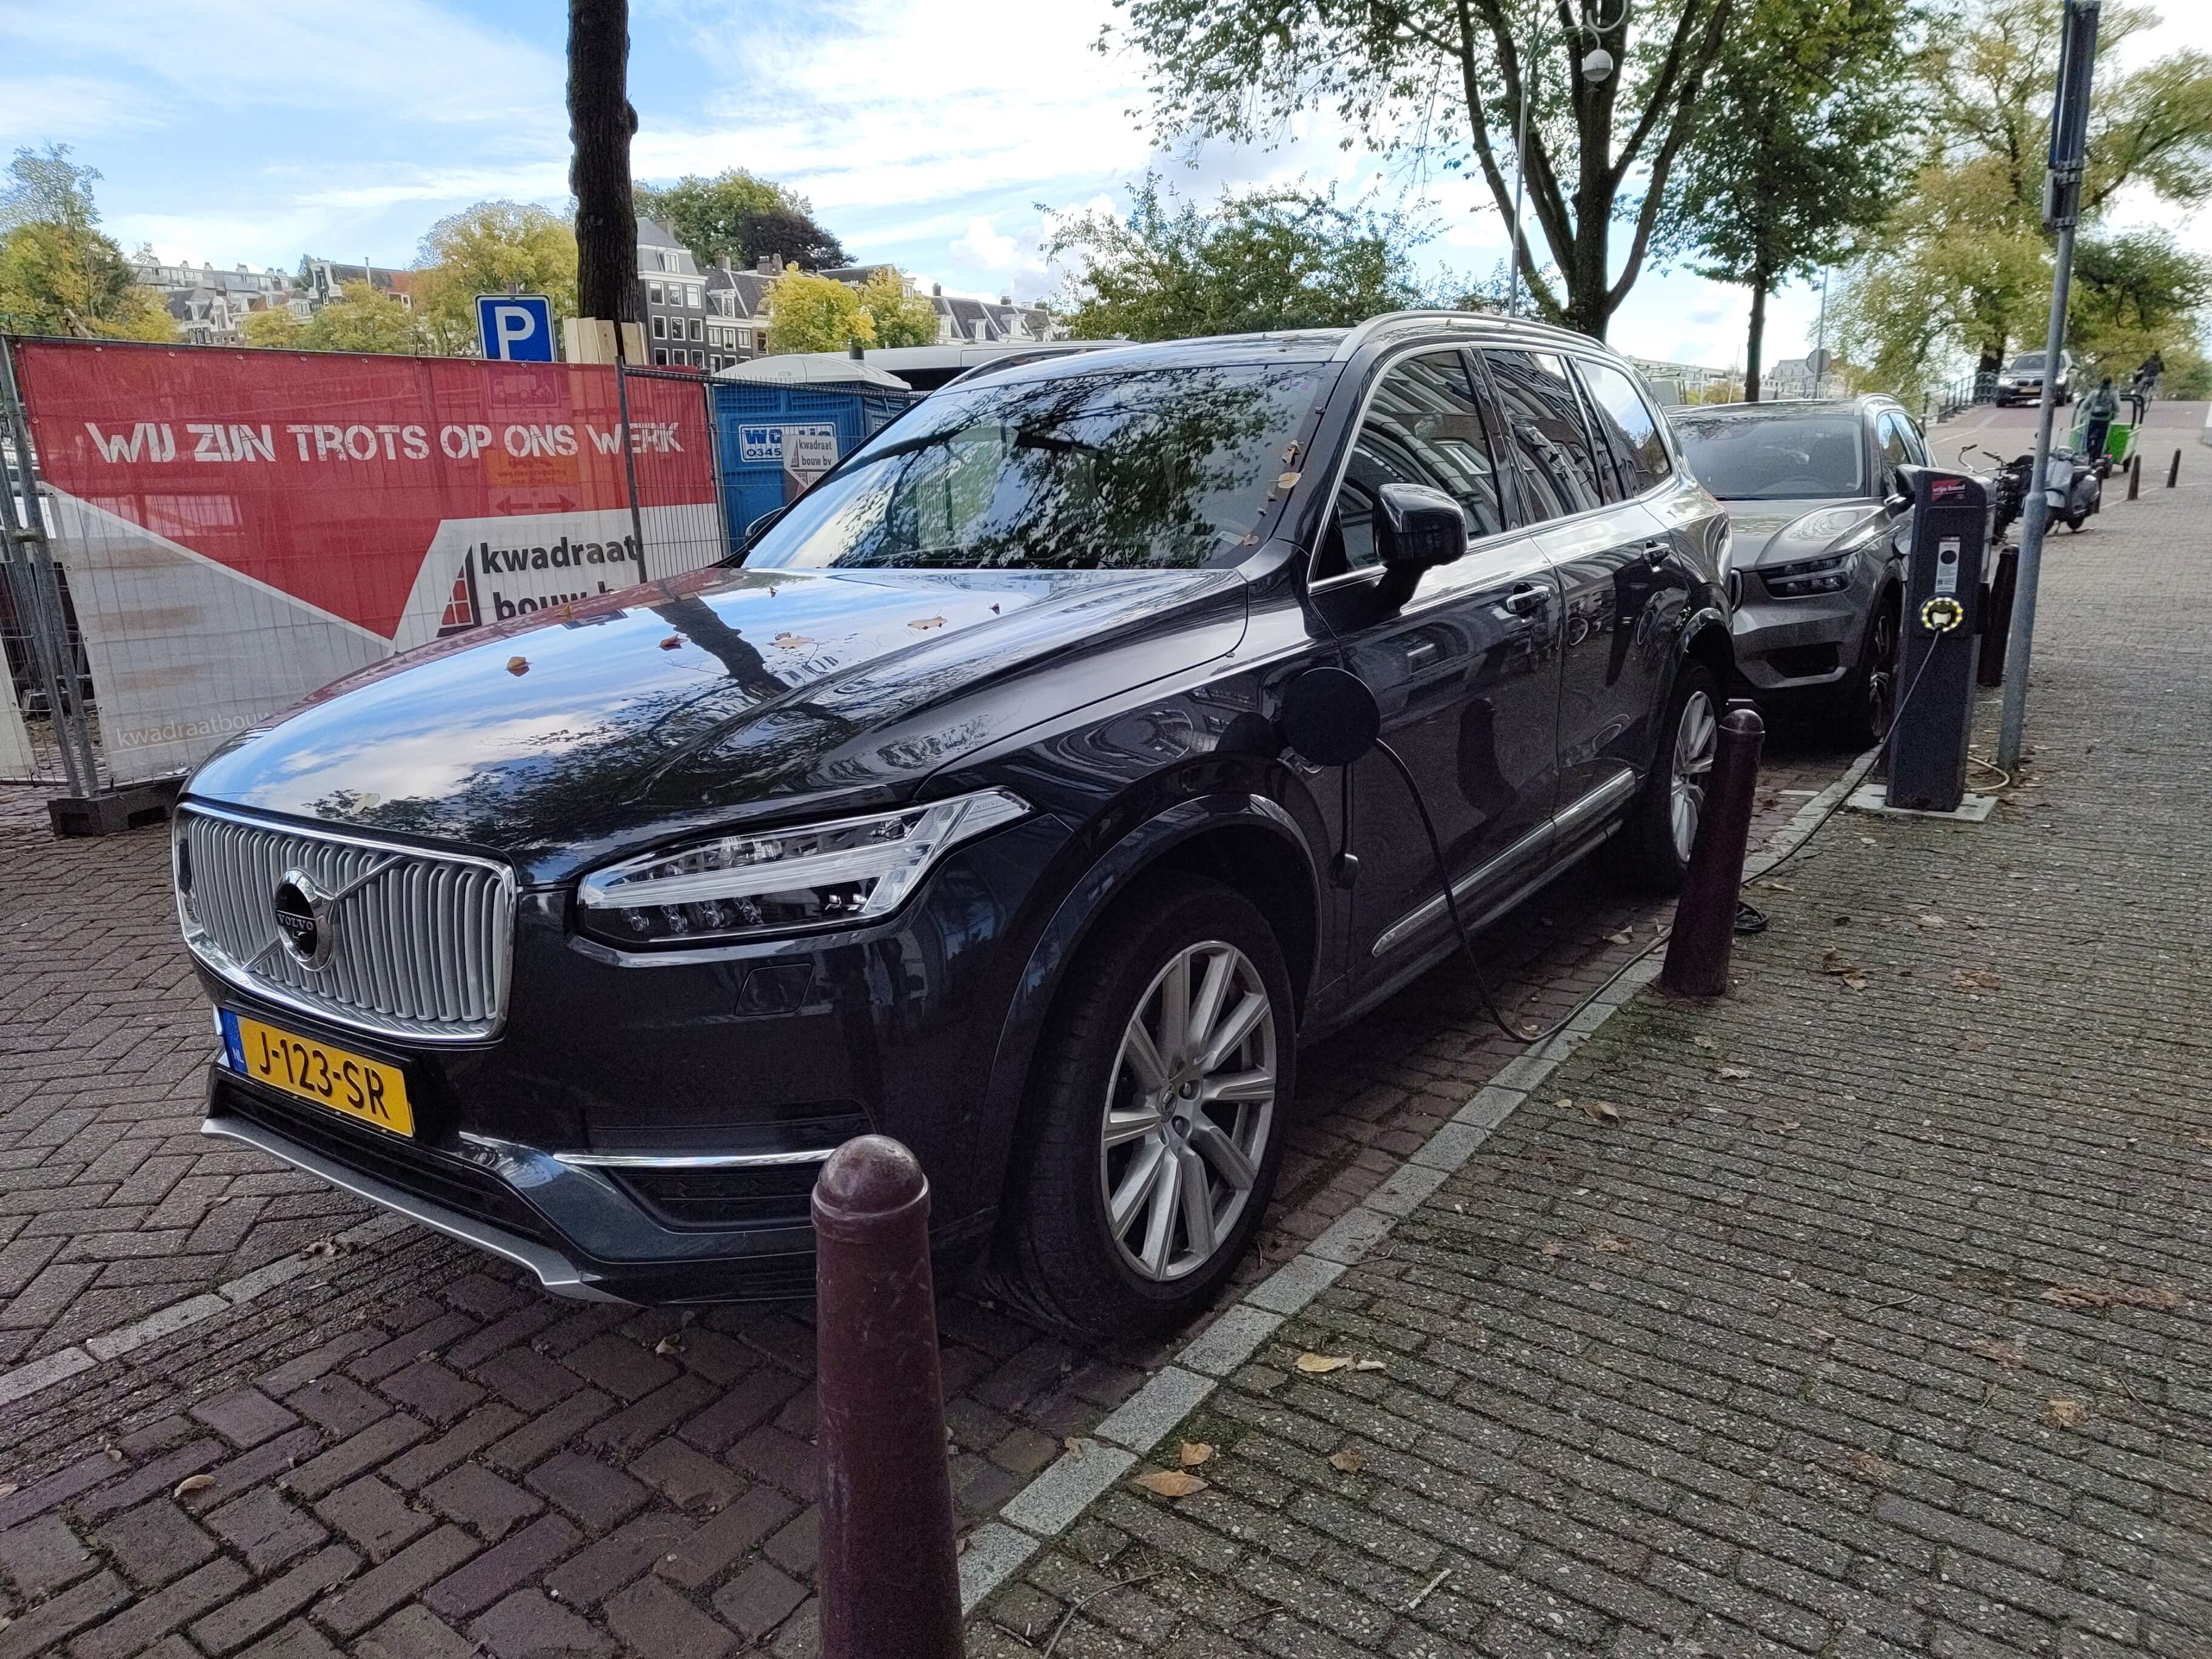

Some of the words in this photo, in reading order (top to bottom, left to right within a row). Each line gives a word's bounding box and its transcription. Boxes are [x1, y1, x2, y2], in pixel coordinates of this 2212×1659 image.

[494, 306, 535, 361] P
[84, 422, 176, 463] WIJ
[186, 423, 277, 462] ZIJN
[286, 424, 429, 461] TROTS
[440, 424, 492, 459] OP
[504, 424, 578, 458] ONS
[585, 421, 685, 455] WERK
[799, 439, 832, 451] kwadraat
[801, 455, 821, 466] bouw
[822, 454, 832, 466] bv
[480, 534, 638, 574] kwadraat
[276, 913, 313, 931] VOLVO
[232, 1047, 244, 1063] NL
[259, 1031, 391, 1121] J-123-SR
